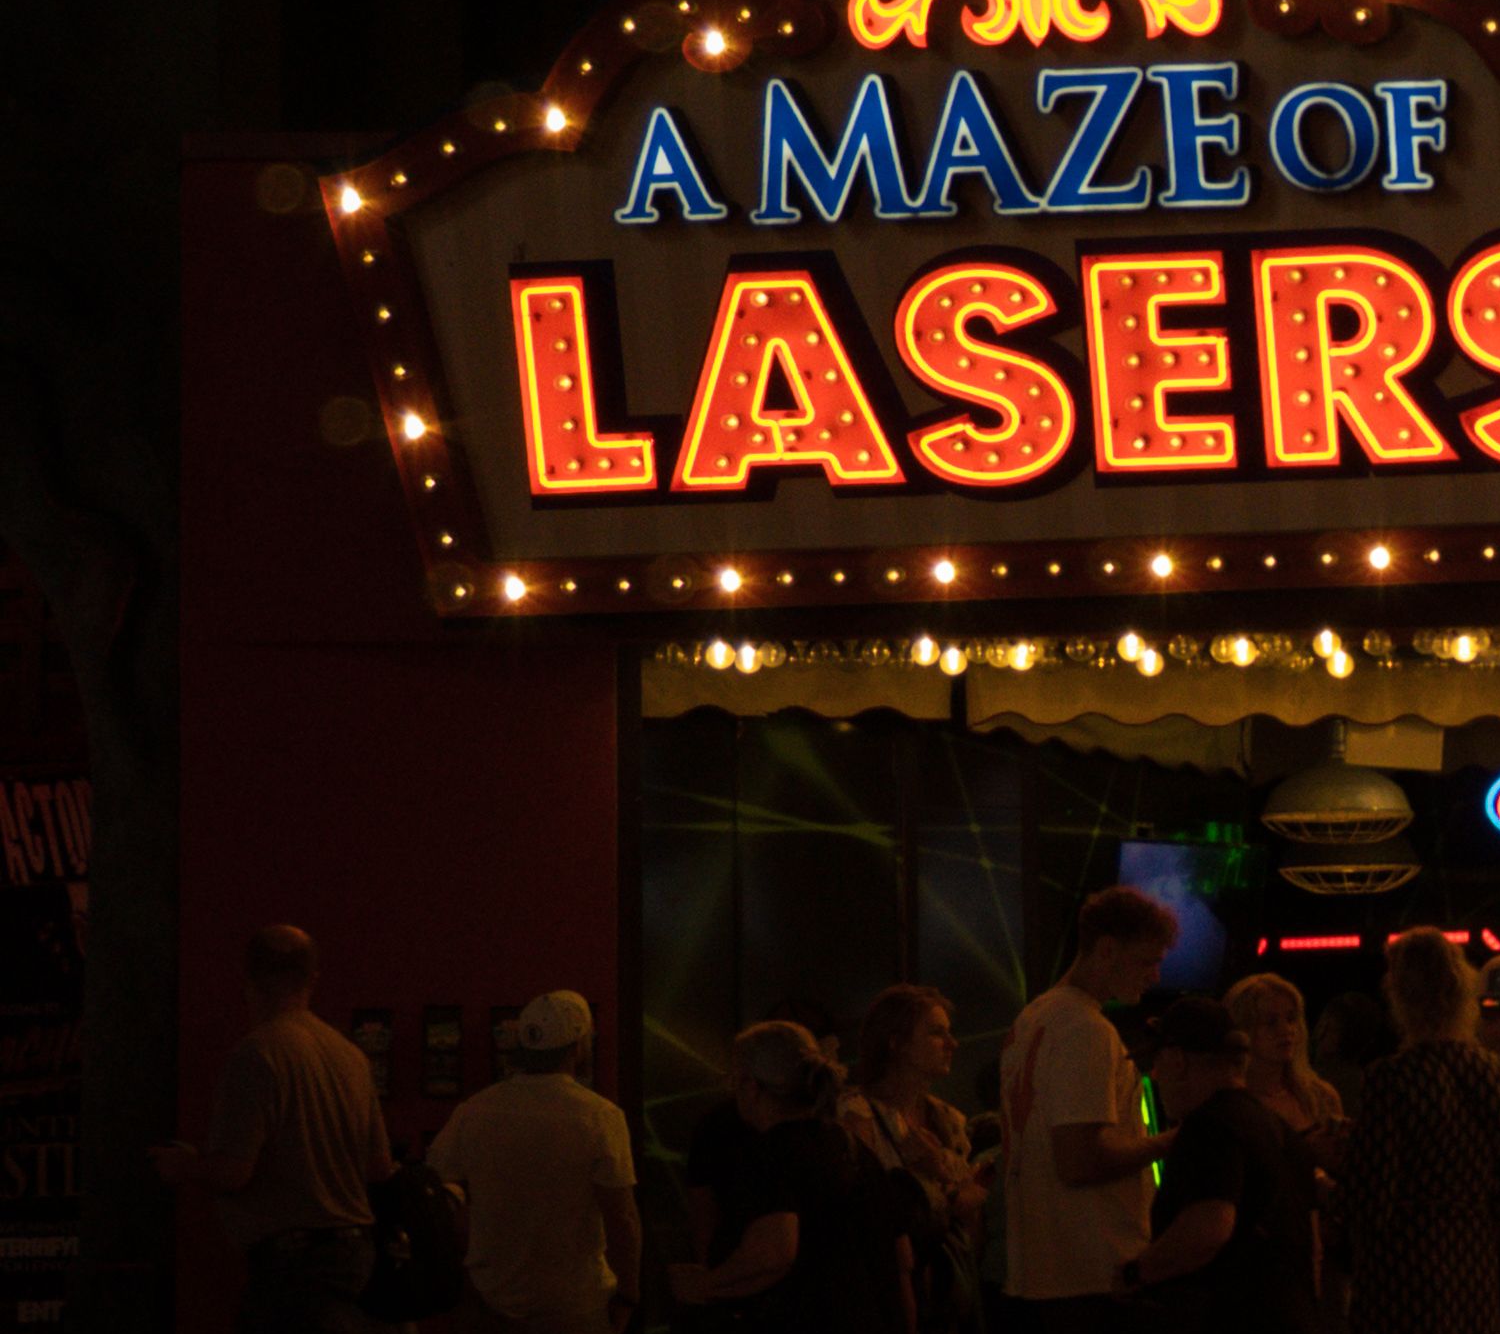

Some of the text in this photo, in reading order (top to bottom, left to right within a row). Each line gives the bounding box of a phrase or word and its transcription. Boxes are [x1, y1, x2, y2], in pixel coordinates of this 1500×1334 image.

[613, 61, 1448, 225] A MAZE OF
